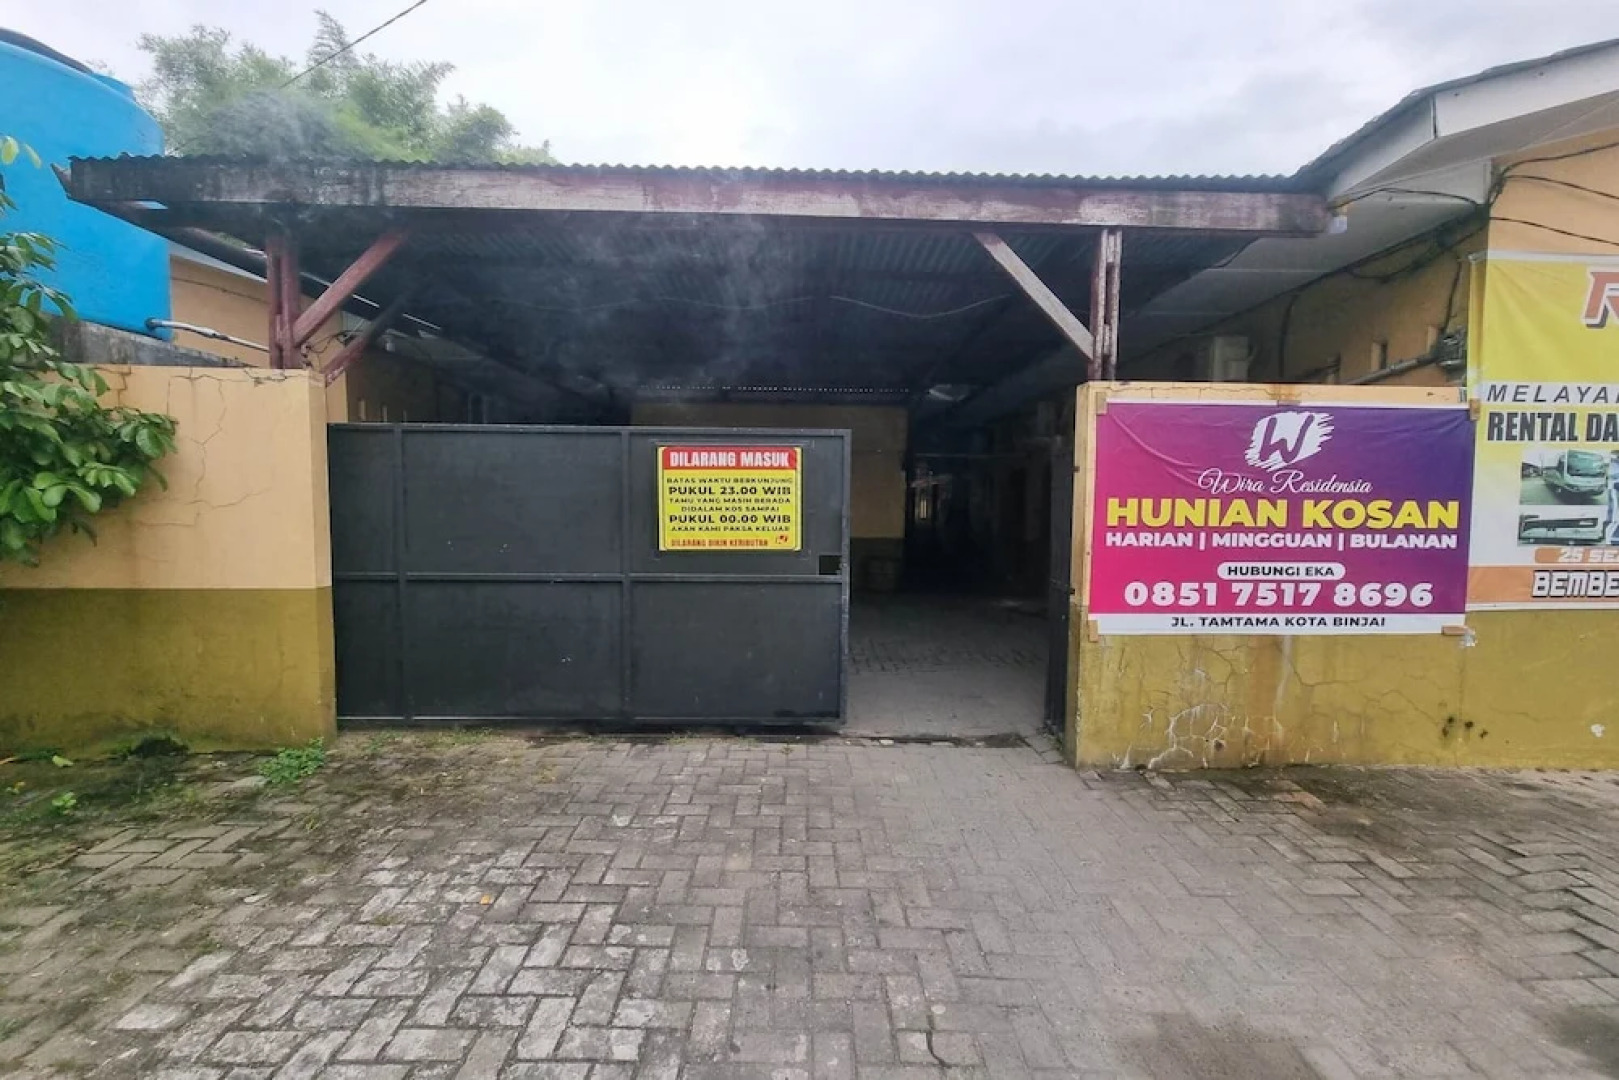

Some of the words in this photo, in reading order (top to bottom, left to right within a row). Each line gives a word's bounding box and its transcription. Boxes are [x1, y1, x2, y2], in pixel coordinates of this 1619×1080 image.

[1487, 384, 1619, 403] MELAYA
[1487, 412, 1578, 441] RENTAL
[670, 451, 736, 467] DILARANG
[740, 451, 789, 467] MASUK
[1198, 468, 1264, 494] Wira
[1270, 469, 1373, 494] Residensia
[668, 486, 716, 495] PUKUL
[720, 486, 757, 495] 23.00
[762, 486, 791, 495] WIB
[669, 514, 715, 523] PUKUL
[720, 514, 758, 523] 00.00
[763, 514, 791, 523] WIB
[1106, 497, 1289, 528] HUNIAN
[1302, 499, 1459, 529] KOSAN
[1105, 532, 1193, 547] HARIAN
[1212, 532, 1332, 548] MINGGUAN
[1350, 533, 1457, 549] BULANAN
[1558, 548, 1584, 562] 25
[1227, 565, 1300, 577] HUBUNGI
[1305, 566, 1335, 577] EKA
[1532, 570, 1619, 598] BEMBE
[1123, 581, 1219, 607] 0851
[1231, 581, 1321, 607] 7517
[1333, 581, 1434, 607] 8696
[1171, 616, 1194, 628] JL.
[1199, 616, 1279, 628] TAMTAMA
[1284, 616, 1328, 628] KOTA
[1333, 615, 1386, 628] BINJAI
